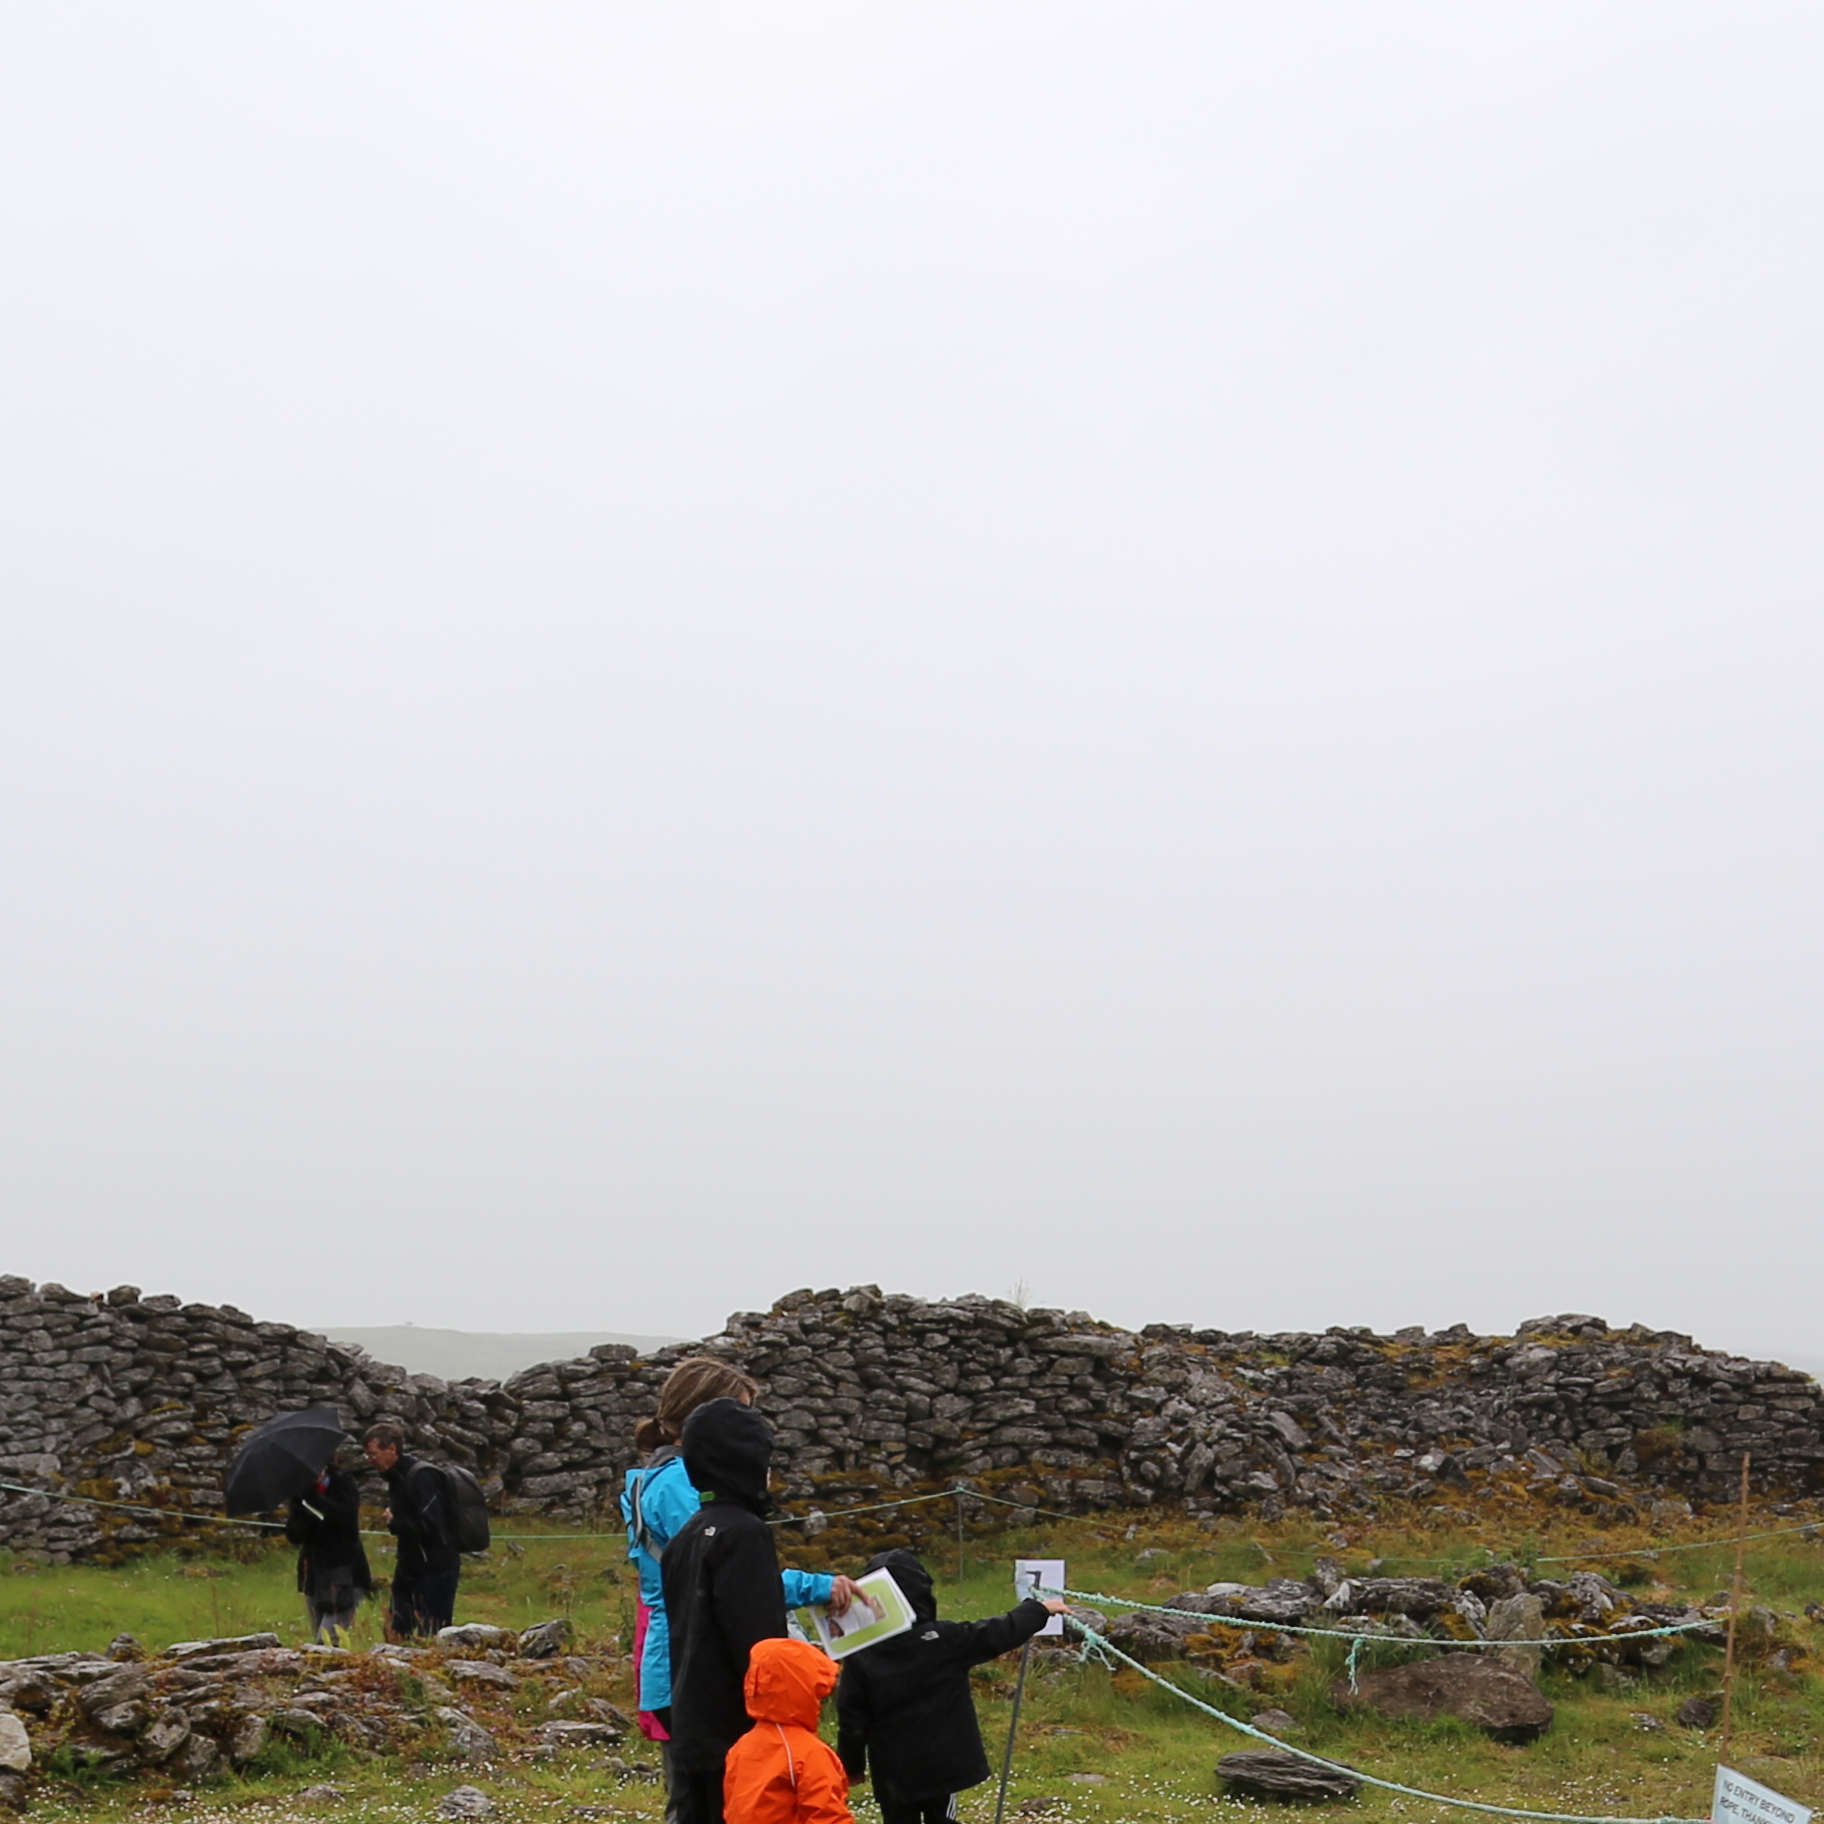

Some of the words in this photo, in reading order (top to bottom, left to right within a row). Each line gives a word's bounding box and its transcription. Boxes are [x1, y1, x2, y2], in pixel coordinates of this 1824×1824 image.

[1723, 1779, 1734, 1792] NO
[1734, 1785, 1761, 1806] ENTRY
[1759, 1799, 1795, 1824] BEYOND
